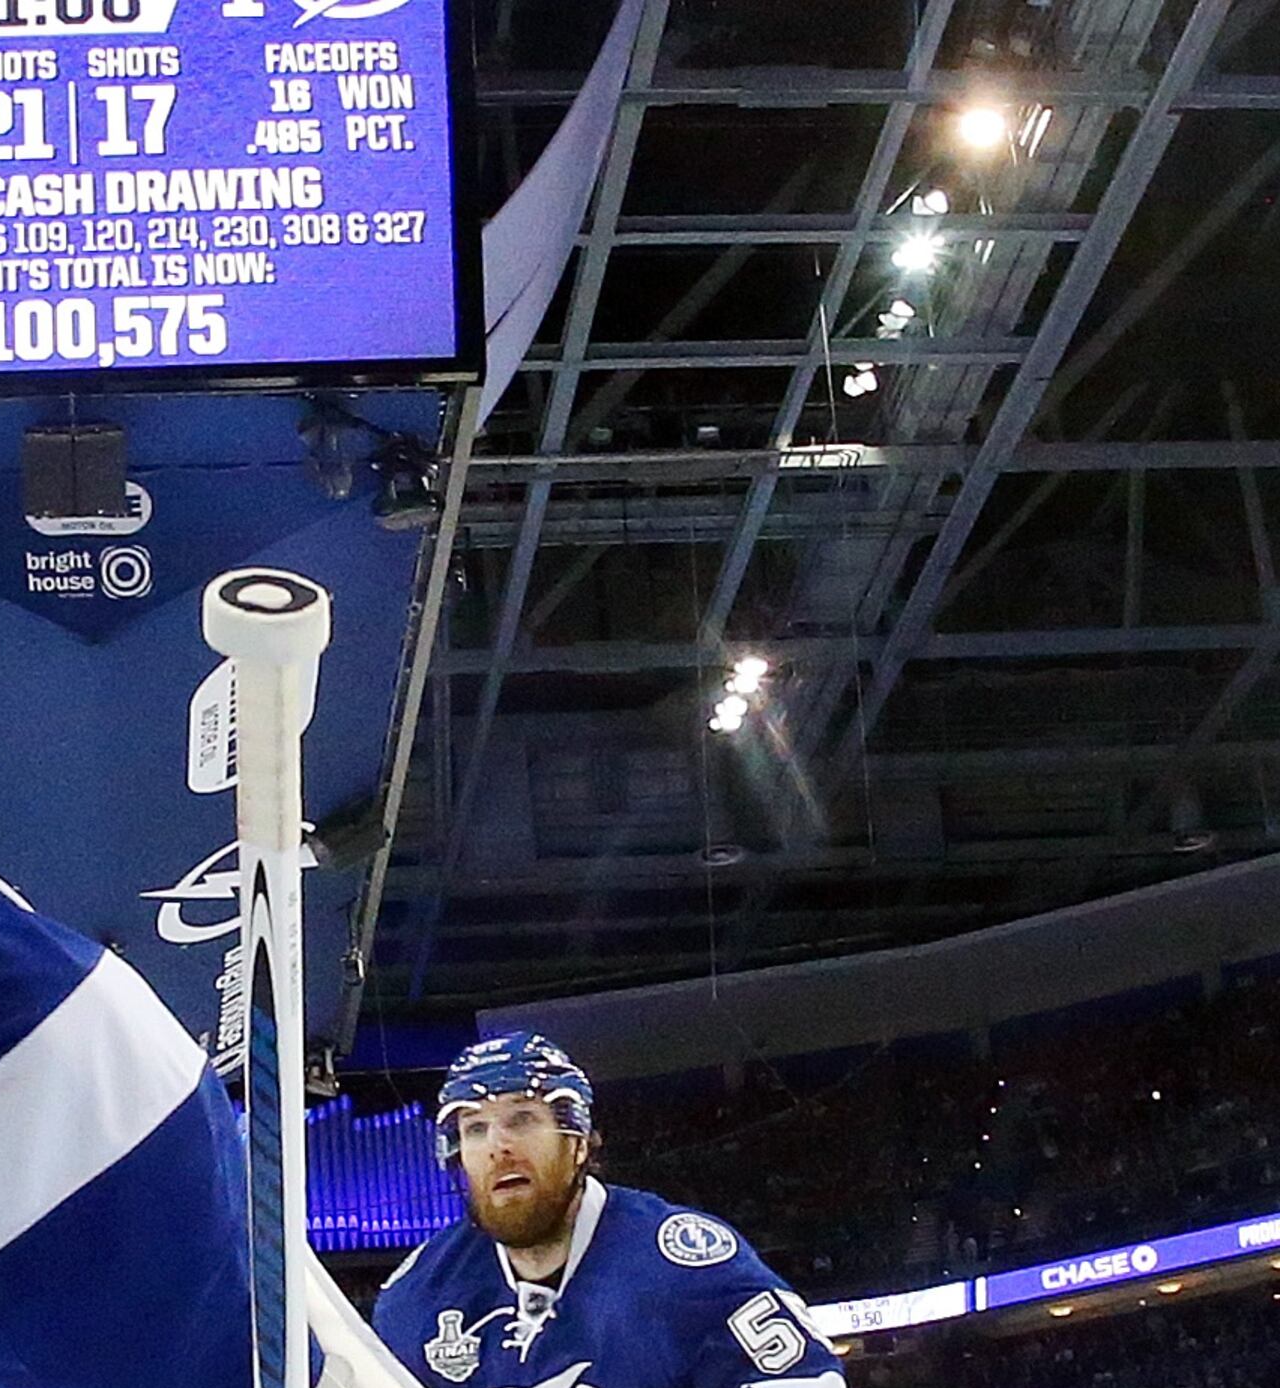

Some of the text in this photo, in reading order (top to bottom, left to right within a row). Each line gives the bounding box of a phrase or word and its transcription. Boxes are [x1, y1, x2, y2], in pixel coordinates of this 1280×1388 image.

[87, 46, 180, 78] SHOTS
[264, 41, 398, 73] FACEOFFS
[269, 74, 415, 113] 16 WON
[95, 84, 177, 157] 17
[246, 115, 415, 155] .485 PCT.
[105, 167, 323, 214] DRAWING
[13, 222, 75, 256] 109,
[81, 218, 142, 253] 120,
[147, 216, 207, 251] 214,
[212, 215, 278, 250] 230,
[282, 213, 341, 246] 308
[346, 212, 369, 245] &
[372, 210, 426, 243] 327
[54, 255, 146, 290] TOTAL
[151, 254, 188, 287] IS
[194, 252, 275, 286] NOW:
[26, 551, 92, 573] bright
[28, 573, 94, 591] house
[1041, 1219, 1280, 1290] CHASE PROU
[727, 1289, 820, 1373] 5
[851, 1311, 883, 1329] 950
